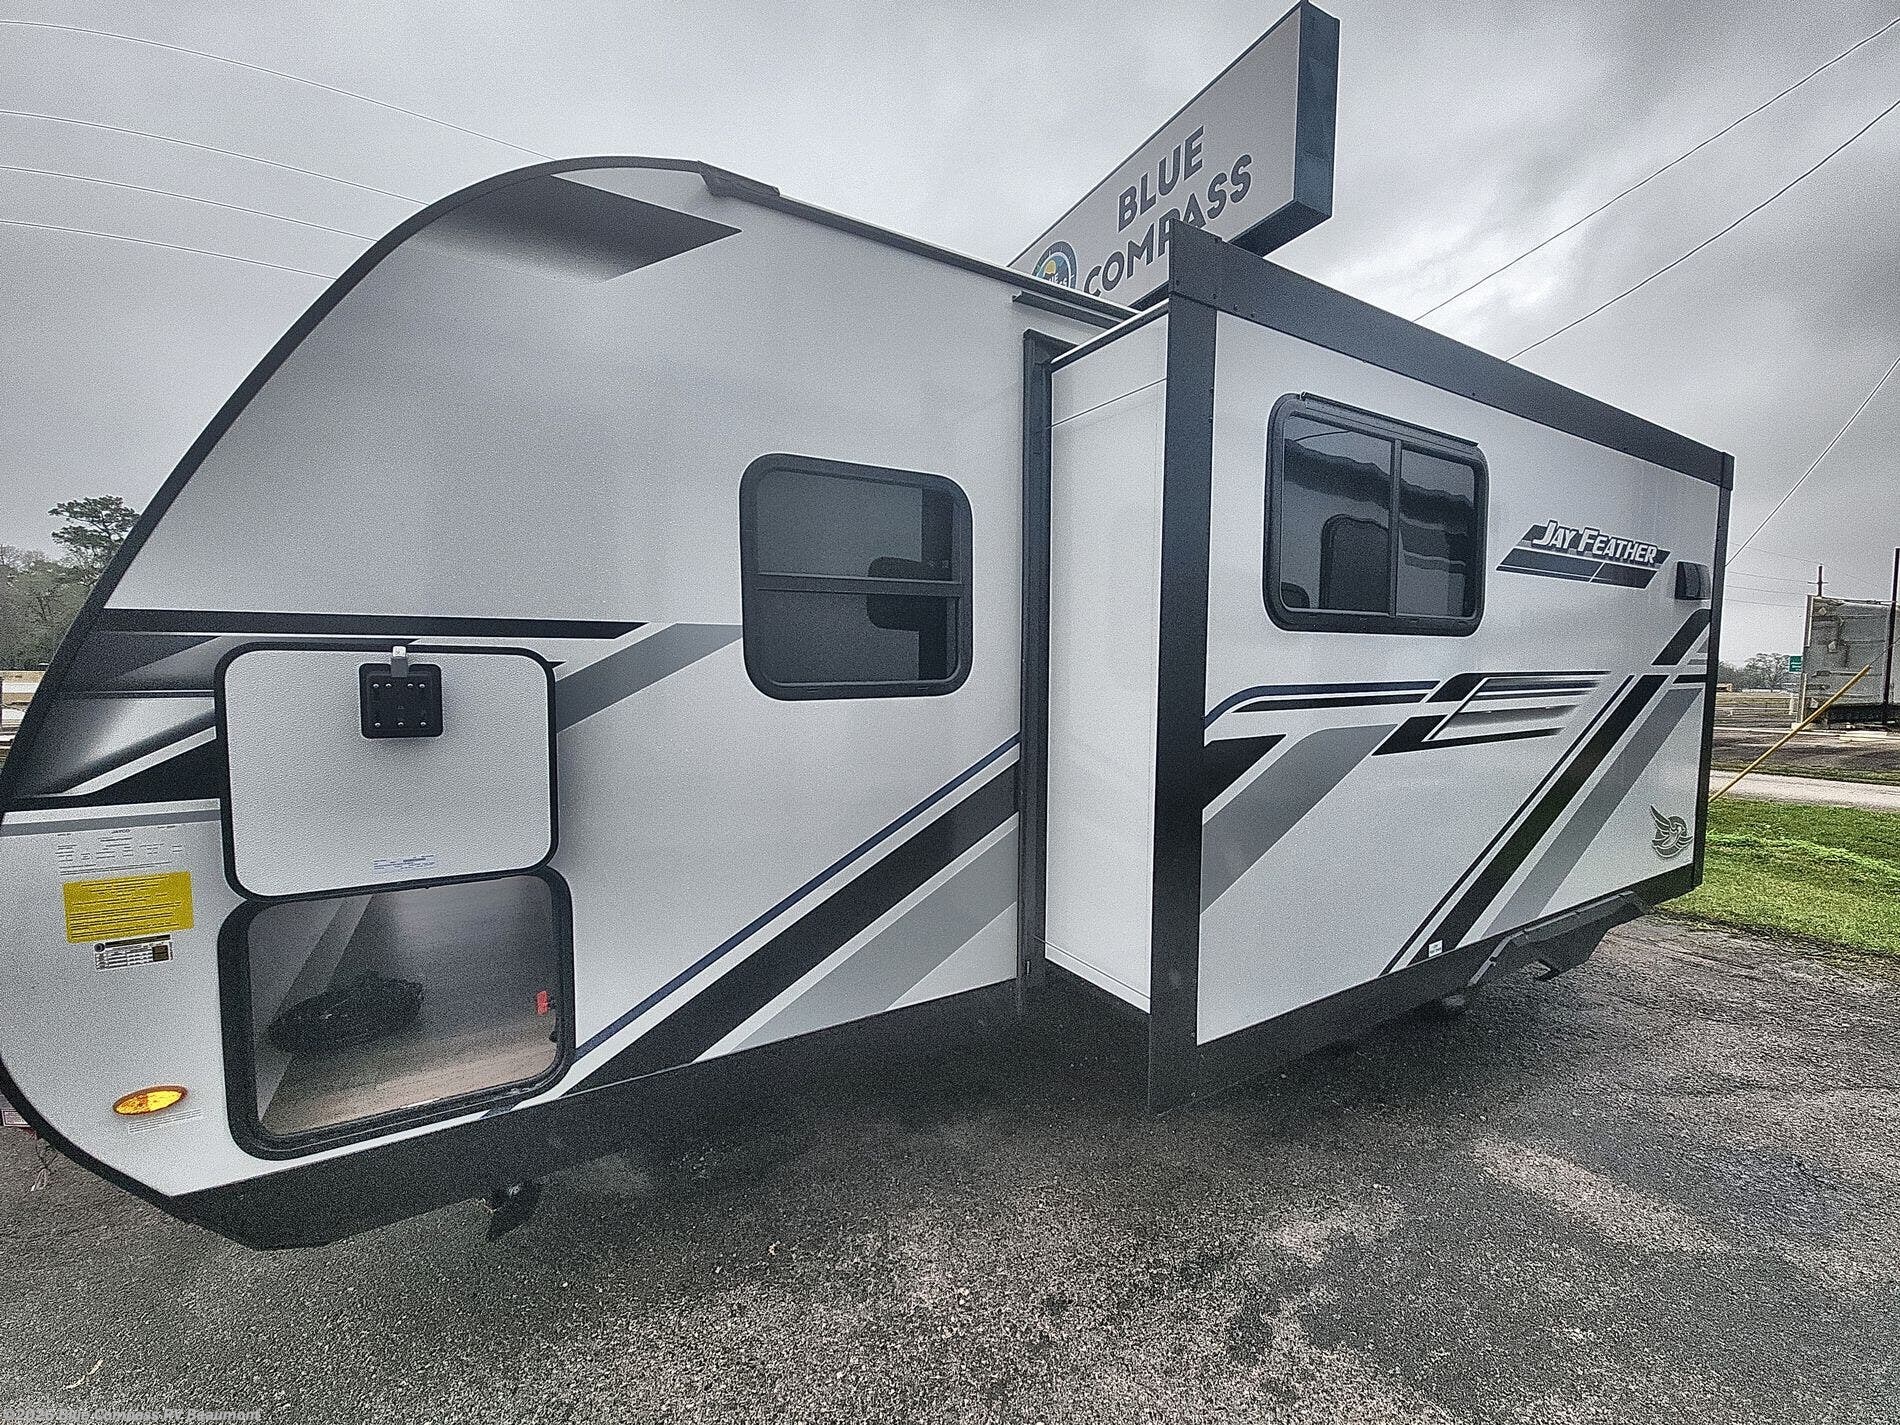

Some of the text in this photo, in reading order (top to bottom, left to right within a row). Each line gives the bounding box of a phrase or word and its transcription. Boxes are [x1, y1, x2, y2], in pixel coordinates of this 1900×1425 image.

[1084, 153, 1252, 297] COMPASS
[1117, 125, 1204, 233] BLUE
[1533, 521, 1657, 564] JAY FEATHER
